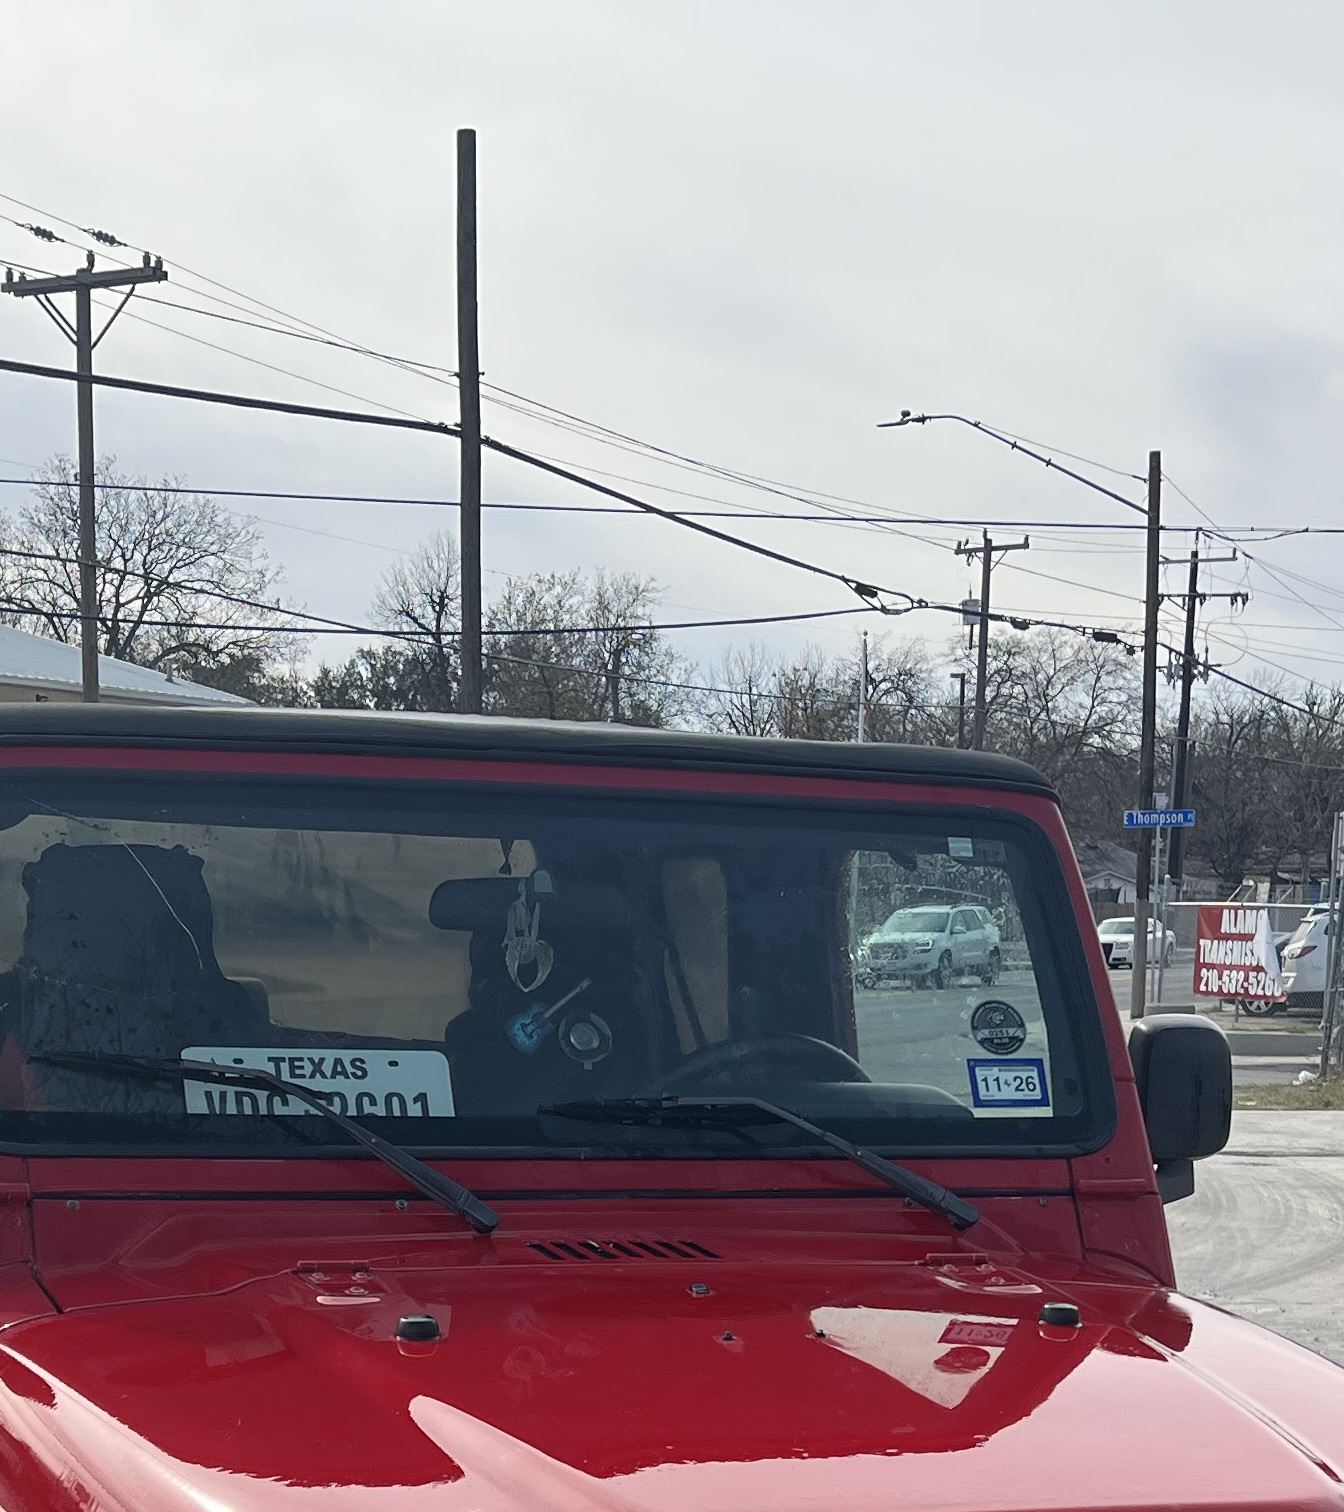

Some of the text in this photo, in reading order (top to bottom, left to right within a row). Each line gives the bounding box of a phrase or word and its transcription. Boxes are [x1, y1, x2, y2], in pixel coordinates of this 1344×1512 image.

[1124, 813, 1129, 825] E
[1133, 812, 1184, 826] Thompson
[267, 1056, 369, 1080] TEXAS
[1013, 1075, 1037, 1092] 26
